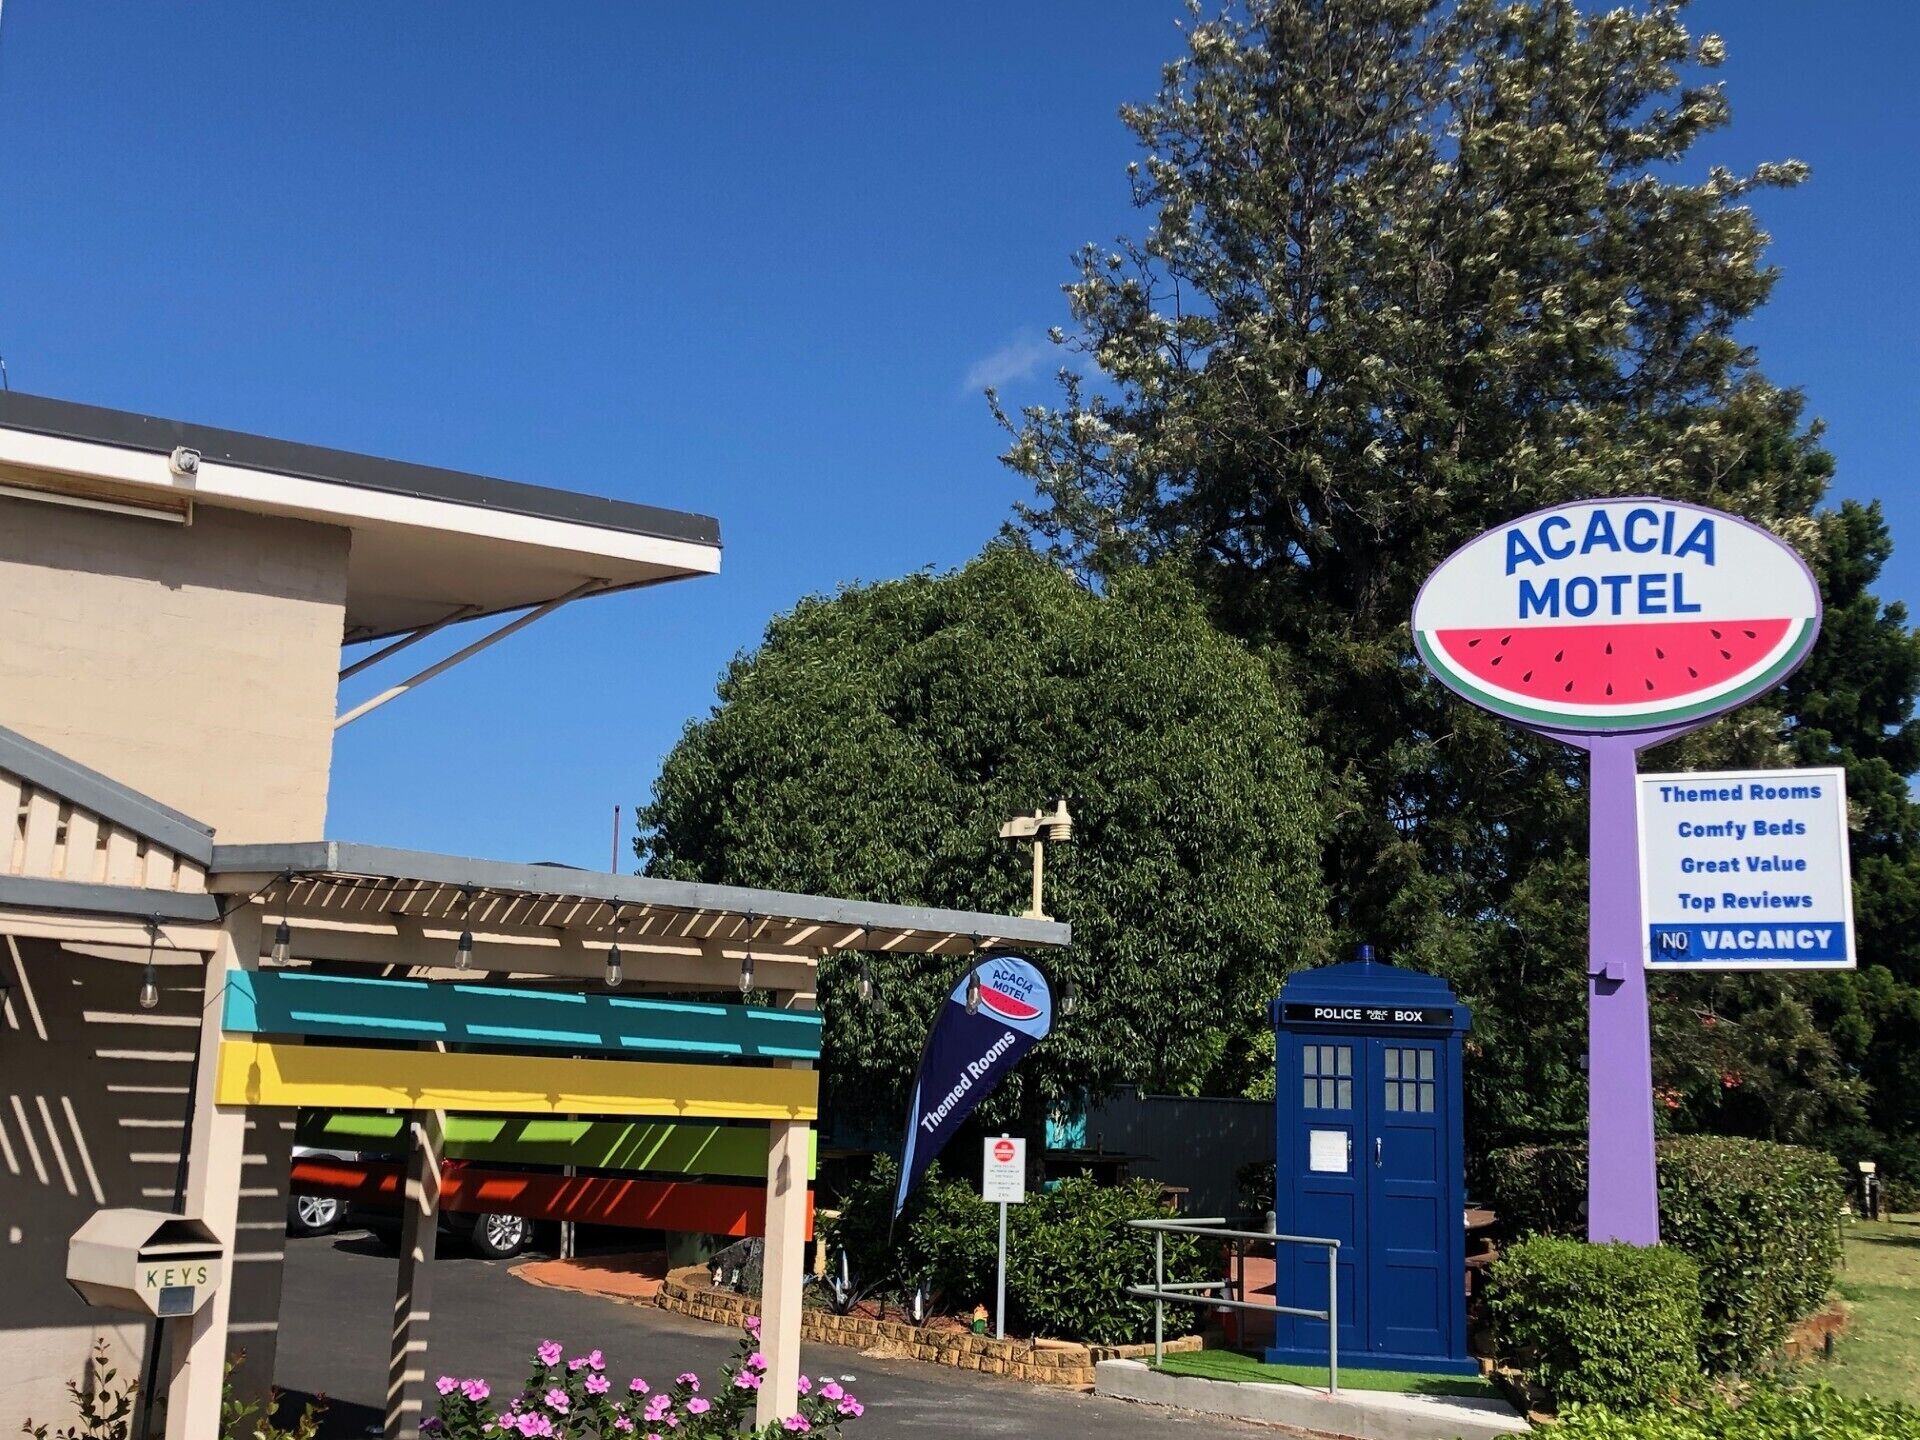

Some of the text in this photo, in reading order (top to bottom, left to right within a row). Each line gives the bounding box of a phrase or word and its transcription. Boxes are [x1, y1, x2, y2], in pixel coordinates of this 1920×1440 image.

[1505, 508, 1716, 576] ACACIA
[1518, 572, 1702, 620] MOTEL
[1660, 784, 1822, 803] Themed Rooms
[1678, 819, 1806, 840] Comfy Beds
[1681, 855, 1807, 873] Great Value
[1678, 891, 1813, 912] Top Reviews
[1662, 929, 1832, 950] NO VACANCY
[993, 969, 1034, 994] ACACIA
[993, 980, 1025, 1002] MOTEL
[1314, 1008, 1362, 1020] POLICE
[1394, 1010, 1423, 1022] BOX
[921, 1031, 1016, 1133] Themed Rooms
[146, 1266, 207, 1288] KEYS
